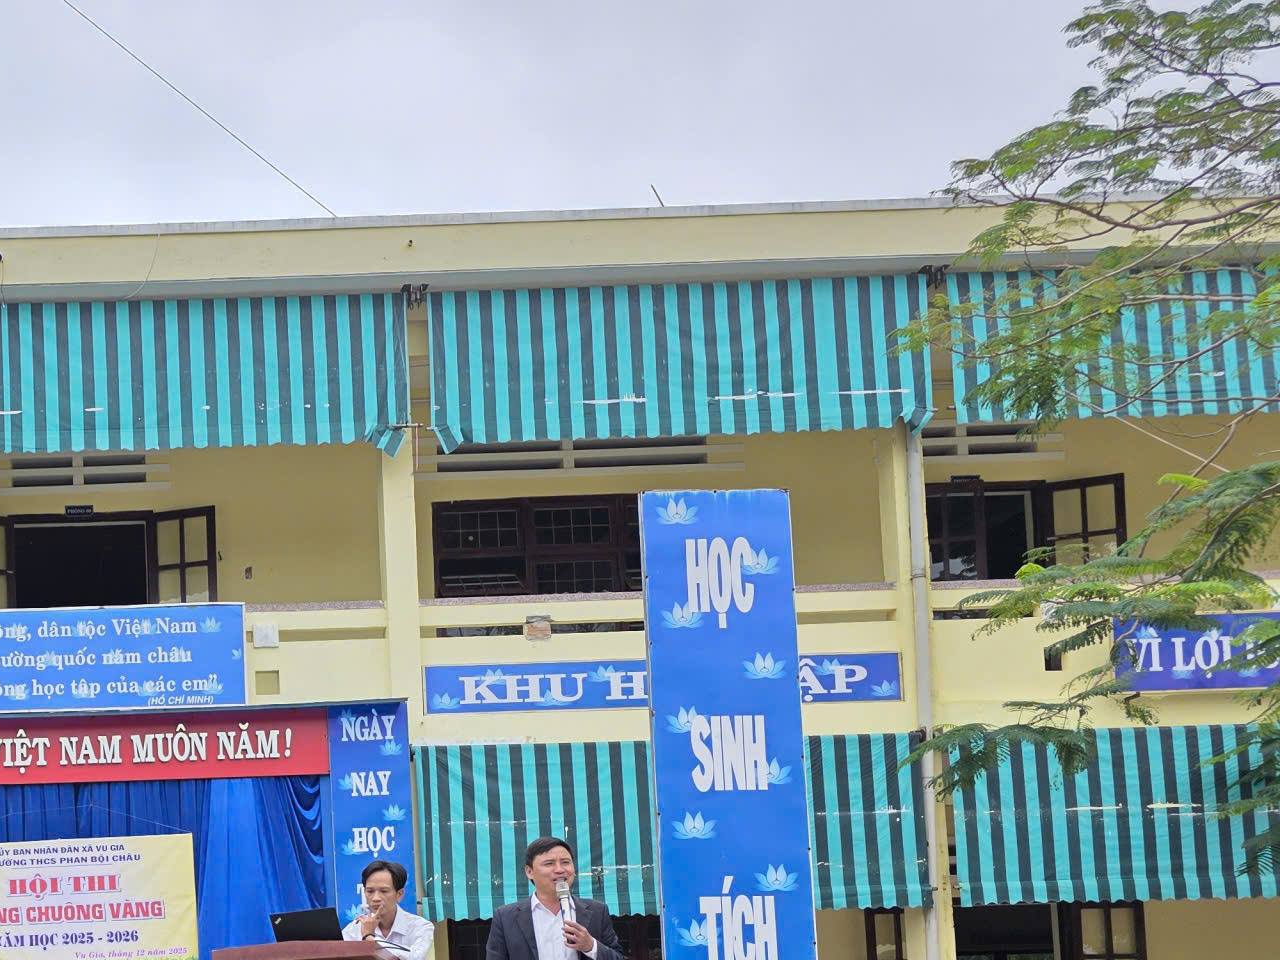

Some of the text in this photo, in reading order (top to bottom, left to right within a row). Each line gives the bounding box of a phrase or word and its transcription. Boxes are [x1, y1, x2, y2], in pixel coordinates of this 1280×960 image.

[685, 536, 755, 629] HỌC
[38, 621, 72, 638] dân
[77, 621, 106, 640] tộc
[112, 618, 149, 638] Việt
[155, 617, 197, 634] Nam
[53, 646, 96, 670] quốc
[102, 649, 141, 665] năm
[148, 646, 192, 664] châu
[32, 679, 65, 700] học
[71, 678, 100, 699] tập
[107, 674, 140, 693] của
[146, 675, 176, 693] các
[458, 673, 587, 705] KHU
[799, 657, 868, 703] ẬP
[167, 694, 185, 705] CHÍ
[186, 694, 214, 705] MINH)
[340, 708, 396, 741] NGÀY
[60, 735, 122, 766] NAM
[132, 724, 208, 763] MUÔN
[690, 714, 769, 793] SINH
[350, 771, 391, 797] NAY
[13, 848, 31, 856] BAN
[33, 846, 59, 855] NHÂN
[110, 844, 125, 852] GIA
[352, 826, 395, 858] HỌC
[30, 858, 57, 866] THCS
[60, 856, 88, 865] PHAN
[90, 854, 109, 865] BỘI
[111, 853, 141, 862] CHÂU
[8, 873, 121, 898] HỘI THI
[26, 902, 107, 925] CHUÔNG
[109, 899, 165, 919] VÀNG
[30, 933, 59, 950] HỌC
[62, 931, 94, 945] 2025
[106, 930, 139, 944] 2026
[136, 949, 145, 957] 12
[147, 948, 166, 956] năm
[169, 947, 188, 955] 2025
